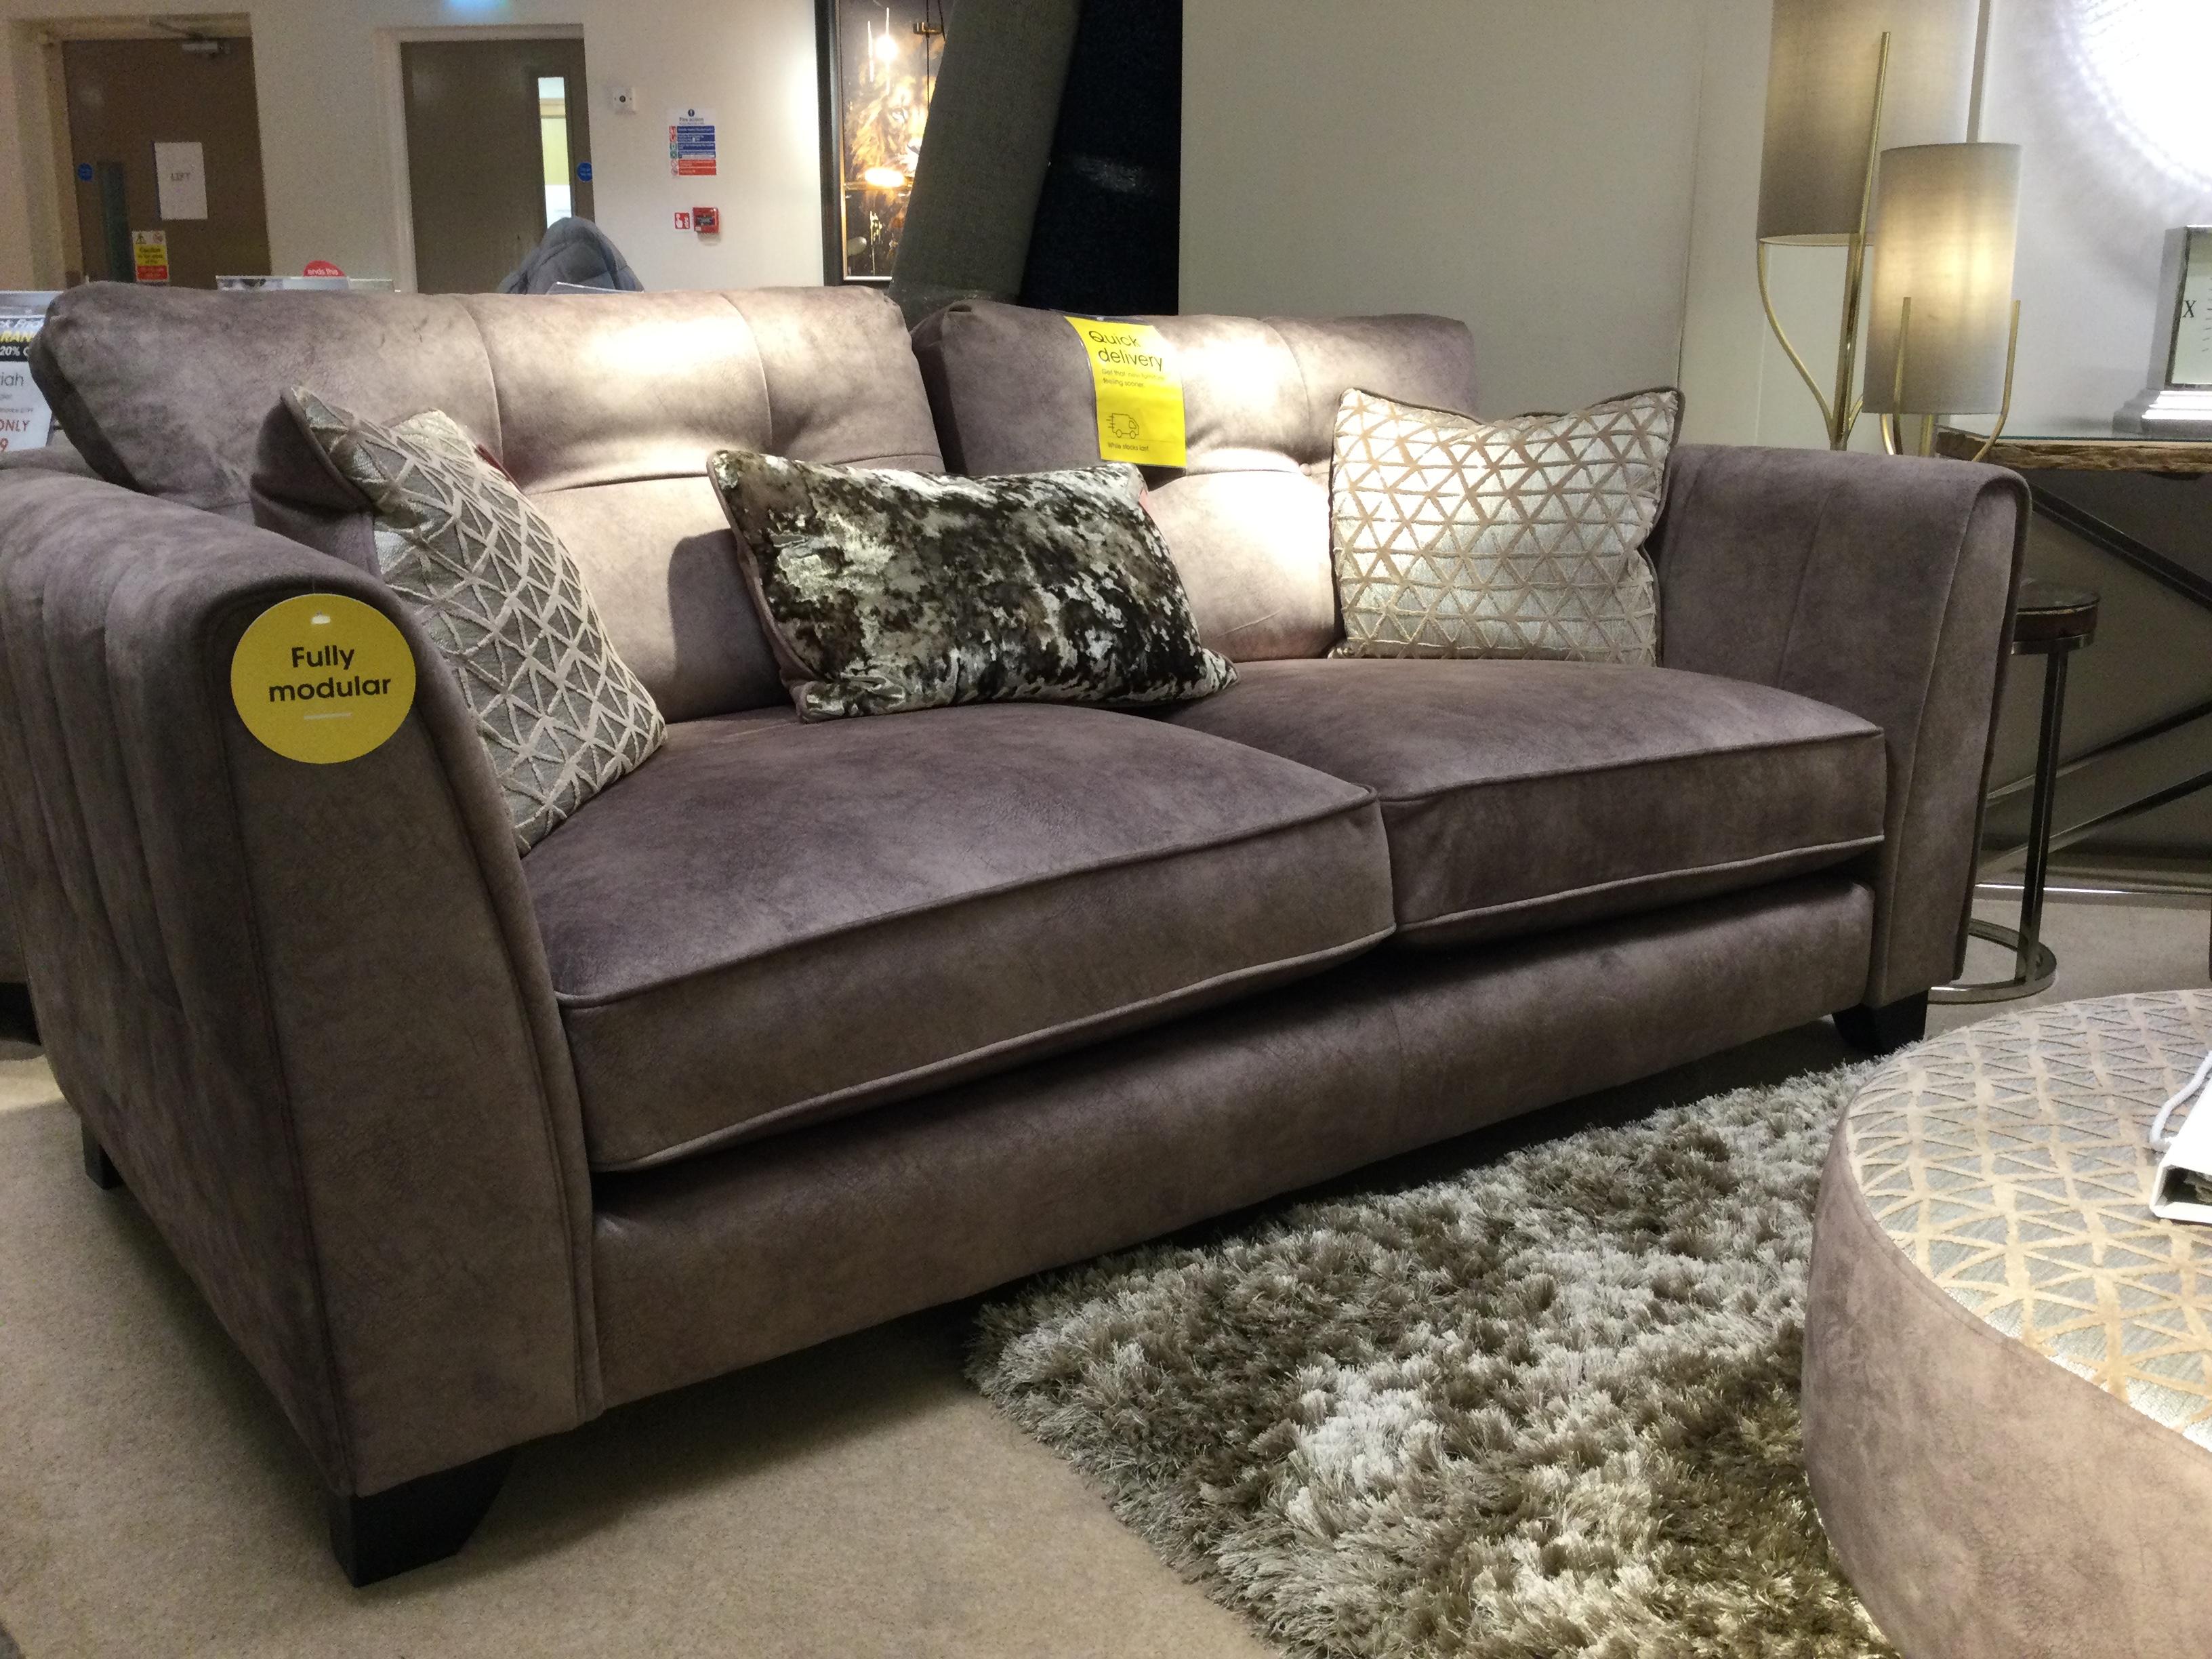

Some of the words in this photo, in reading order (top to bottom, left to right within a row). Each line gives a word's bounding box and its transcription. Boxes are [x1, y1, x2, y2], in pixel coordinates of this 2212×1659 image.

[1088, 331, 1141, 347] Quick
[0, 346, 20, 356] 20%
[1098, 348, 1162, 371] delivery
[0, 371, 24, 386] iah
[1103, 377, 1124, 386] feeling
[291, 645, 354, 670] Fully
[269, 676, 391, 702] modular
